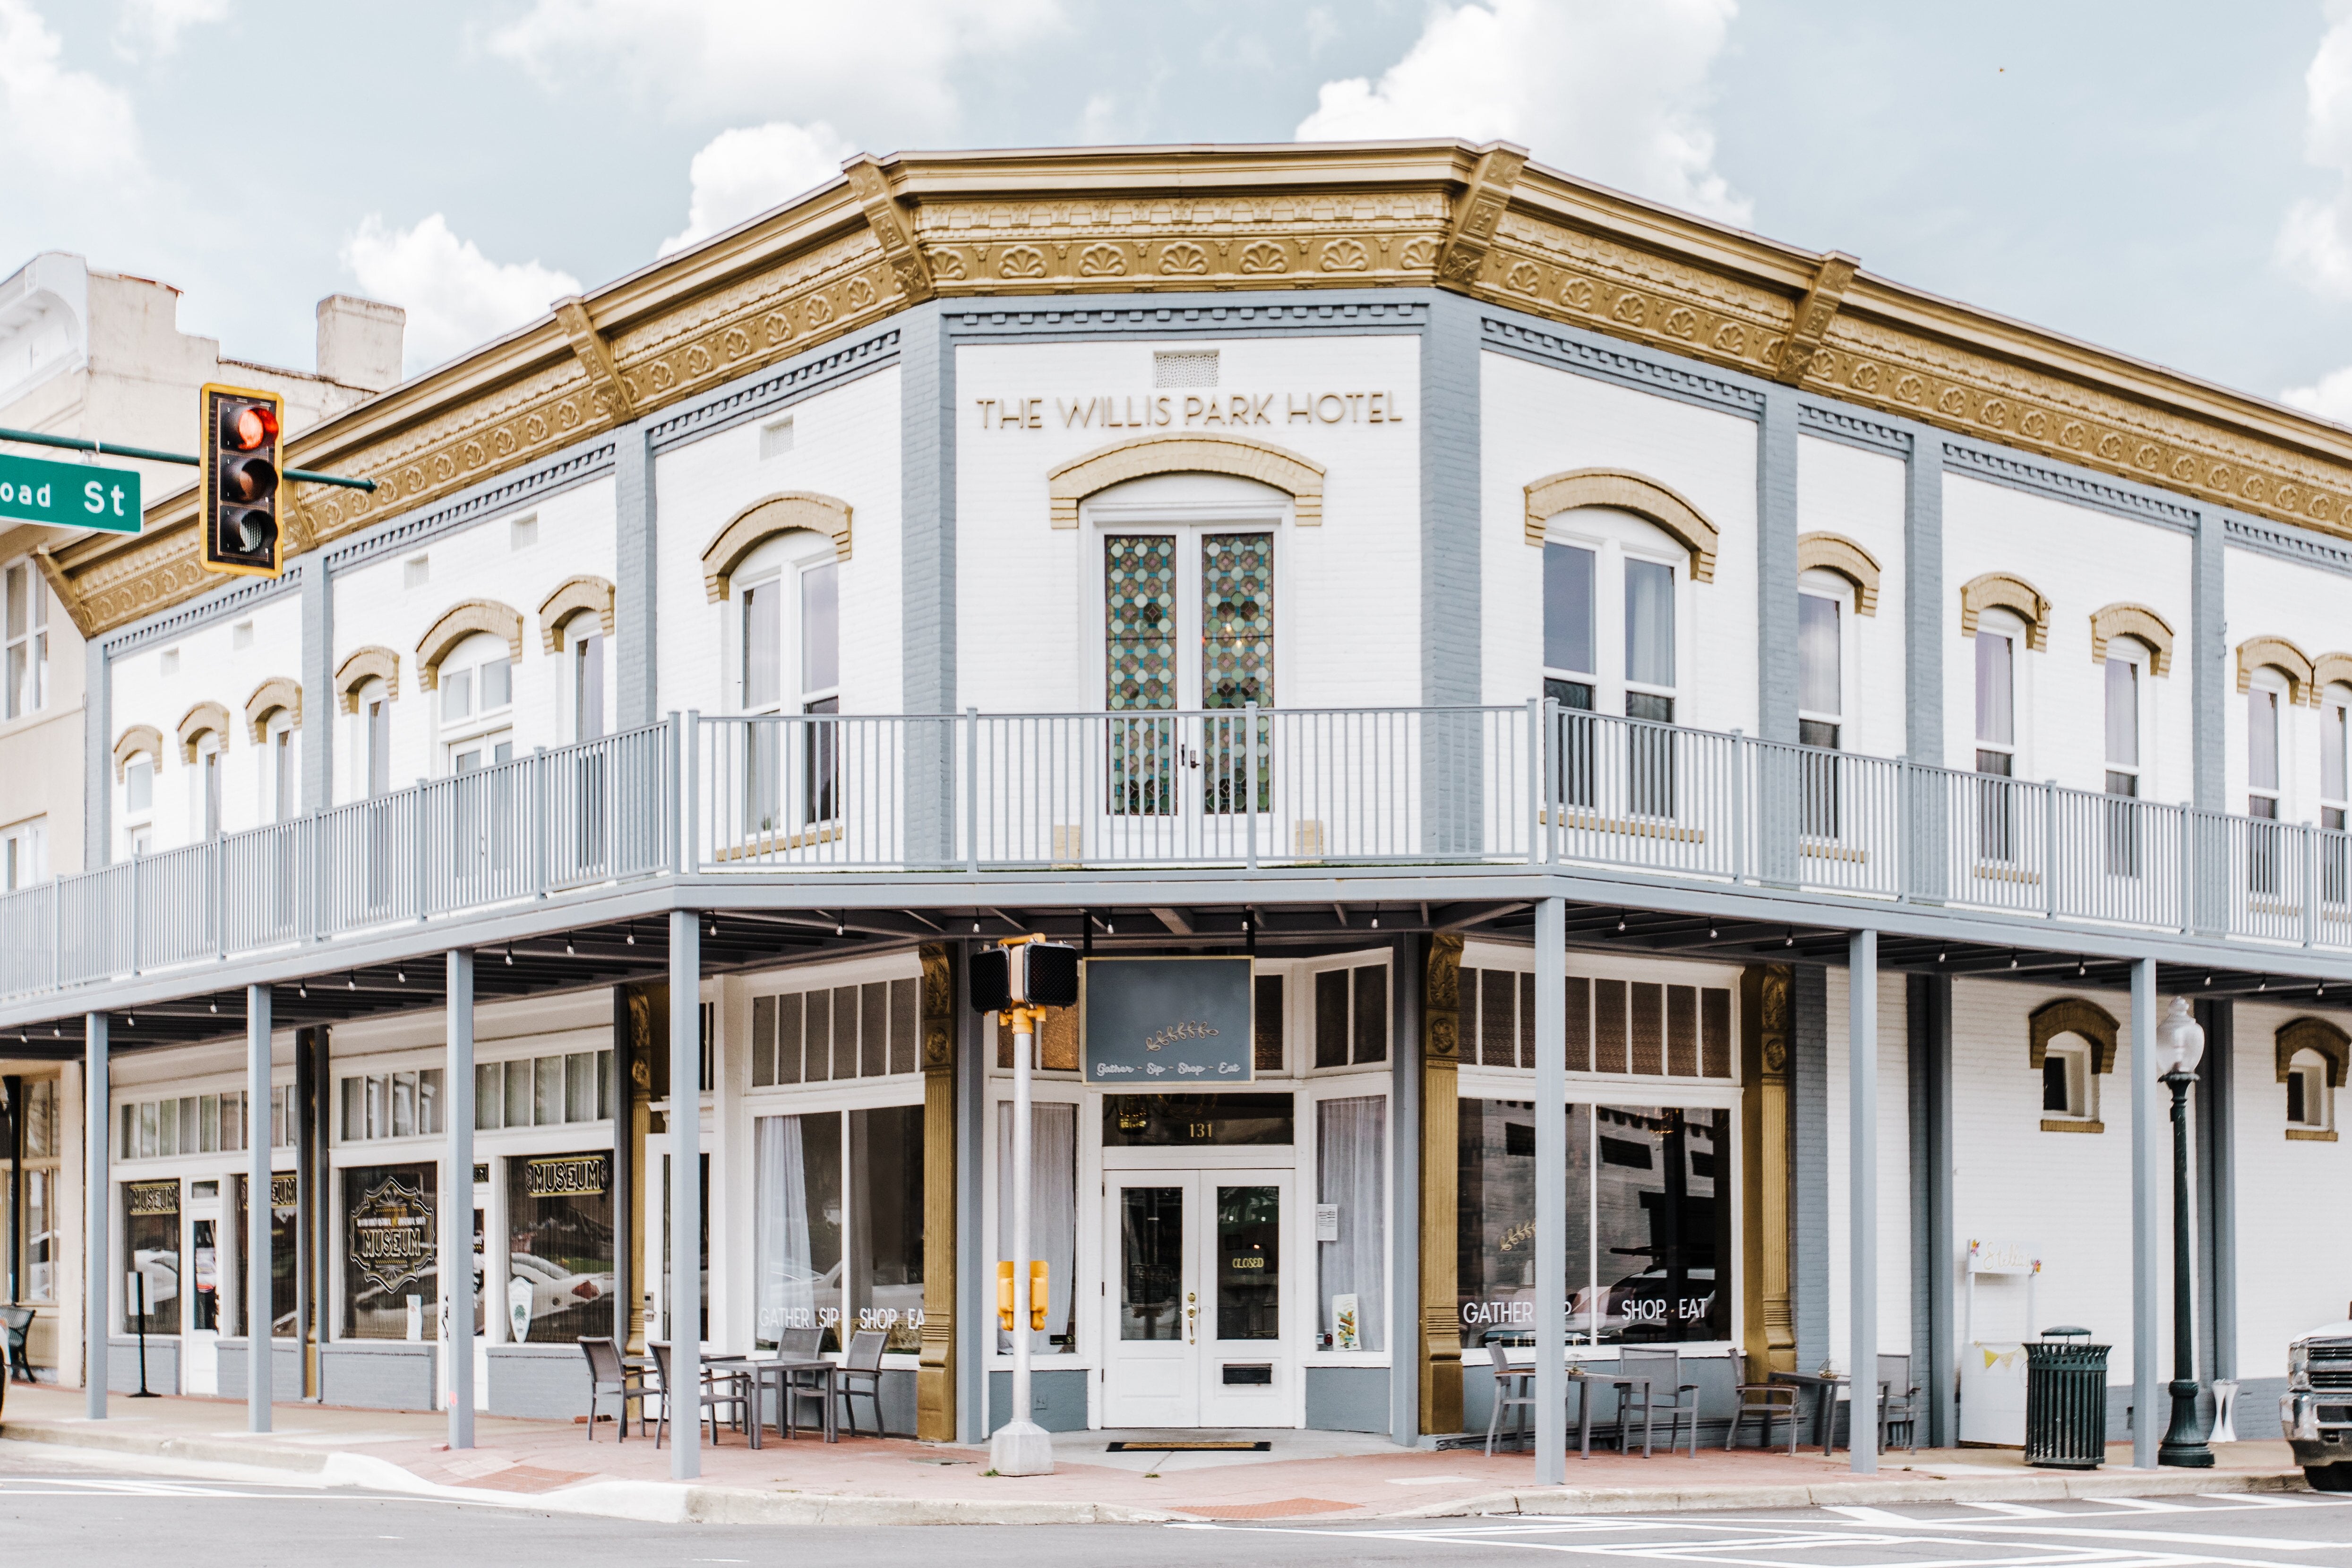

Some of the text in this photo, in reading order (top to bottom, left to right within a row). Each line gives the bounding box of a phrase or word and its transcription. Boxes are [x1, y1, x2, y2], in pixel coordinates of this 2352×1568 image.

[976, 392, 1403, 429] THE WILLIS PARK HOTEL
[84, 481, 125, 516] St
[1097, 1062, 1241, 1077] Gather Sip Shop Eat
[1190, 1123, 1212, 1138] 131
[532, 1160, 600, 1193] MUSEUM
[131, 1186, 176, 1212] MUSEUM
[271, 1178, 297, 1206] EUM
[362, 1228, 421, 1258] MUSEUM
[1232, 1257, 1264, 1268] CLOSED
[759, 1307, 840, 1328] GATHER SIP
[859, 1307, 925, 1330] SHOP EA
[1463, 1302, 1534, 1324] GATHER
[1622, 1298, 1708, 1320] SHOP EAT
